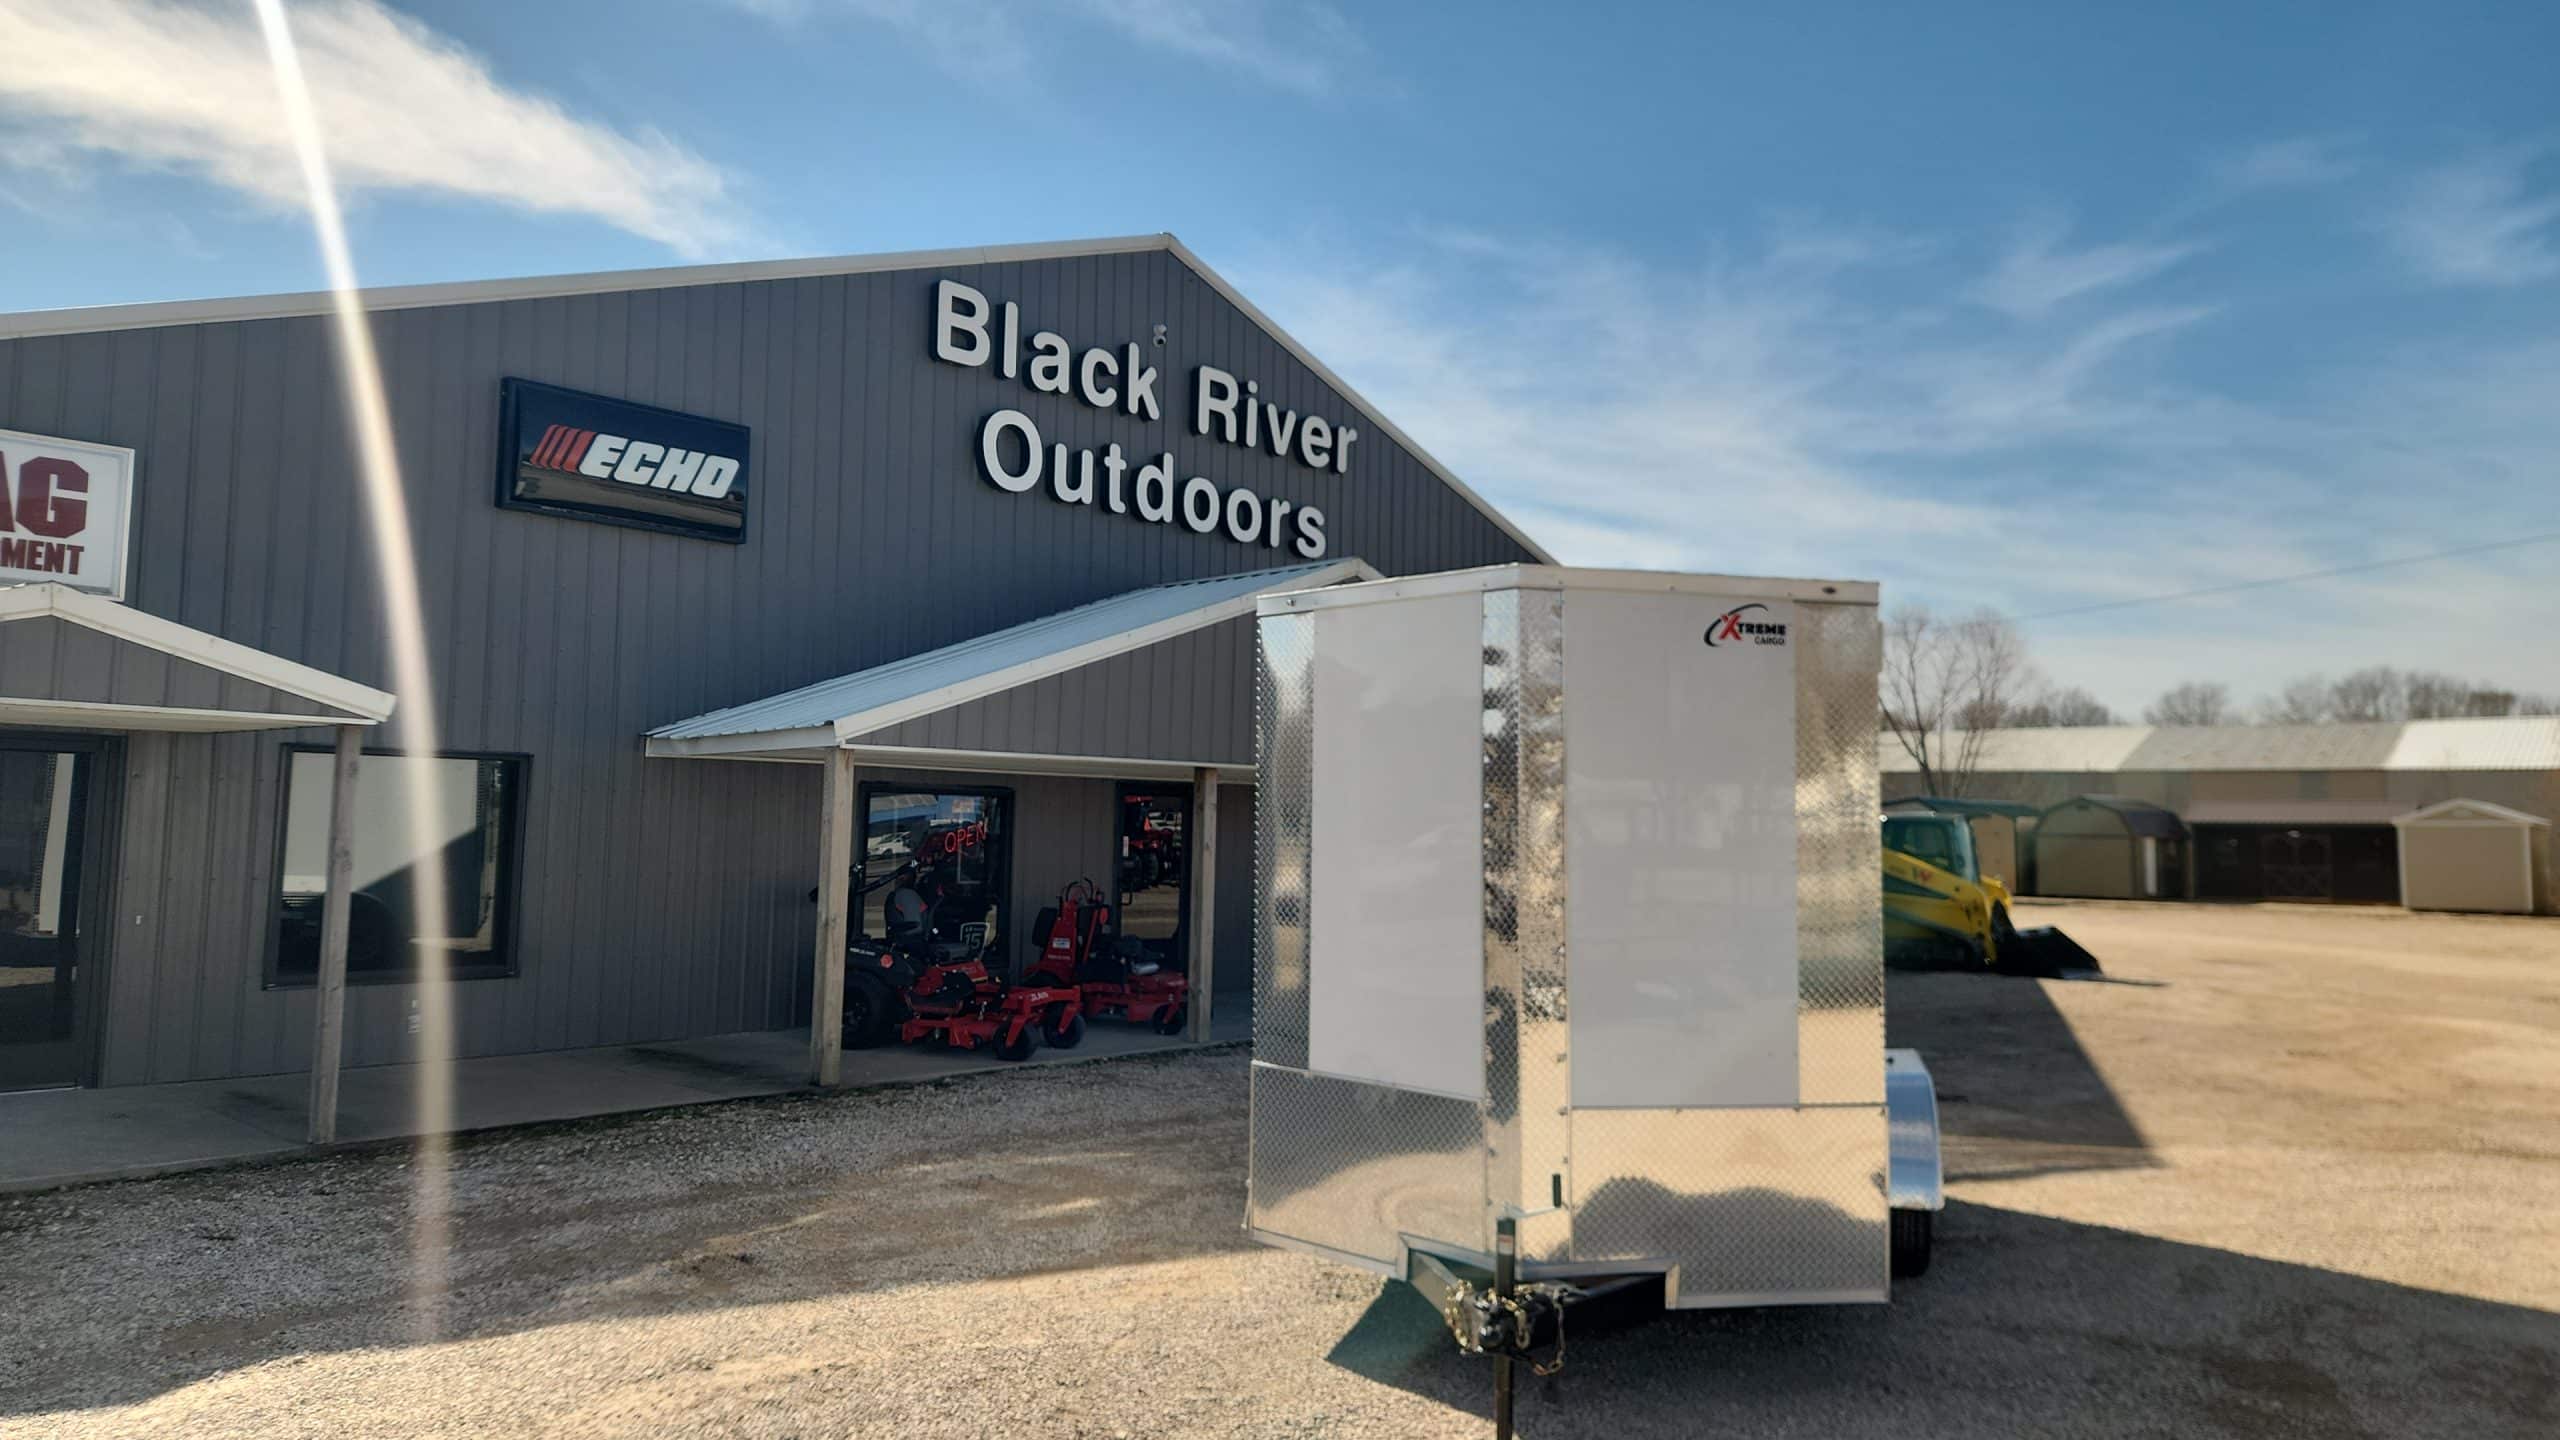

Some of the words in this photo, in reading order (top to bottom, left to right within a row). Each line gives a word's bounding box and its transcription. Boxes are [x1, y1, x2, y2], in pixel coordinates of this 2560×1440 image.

[937, 279, 1160, 421] Black
[1196, 364, 1358, 474] River
[578, 433, 740, 499] ECHO
[982, 409, 1327, 560] Outdoors
[0, 537, 85, 575] MENT
[1719, 613, 1786, 641] XTREME
[1754, 636, 1786, 646] CARGO
[945, 818, 988, 853] OPEN
